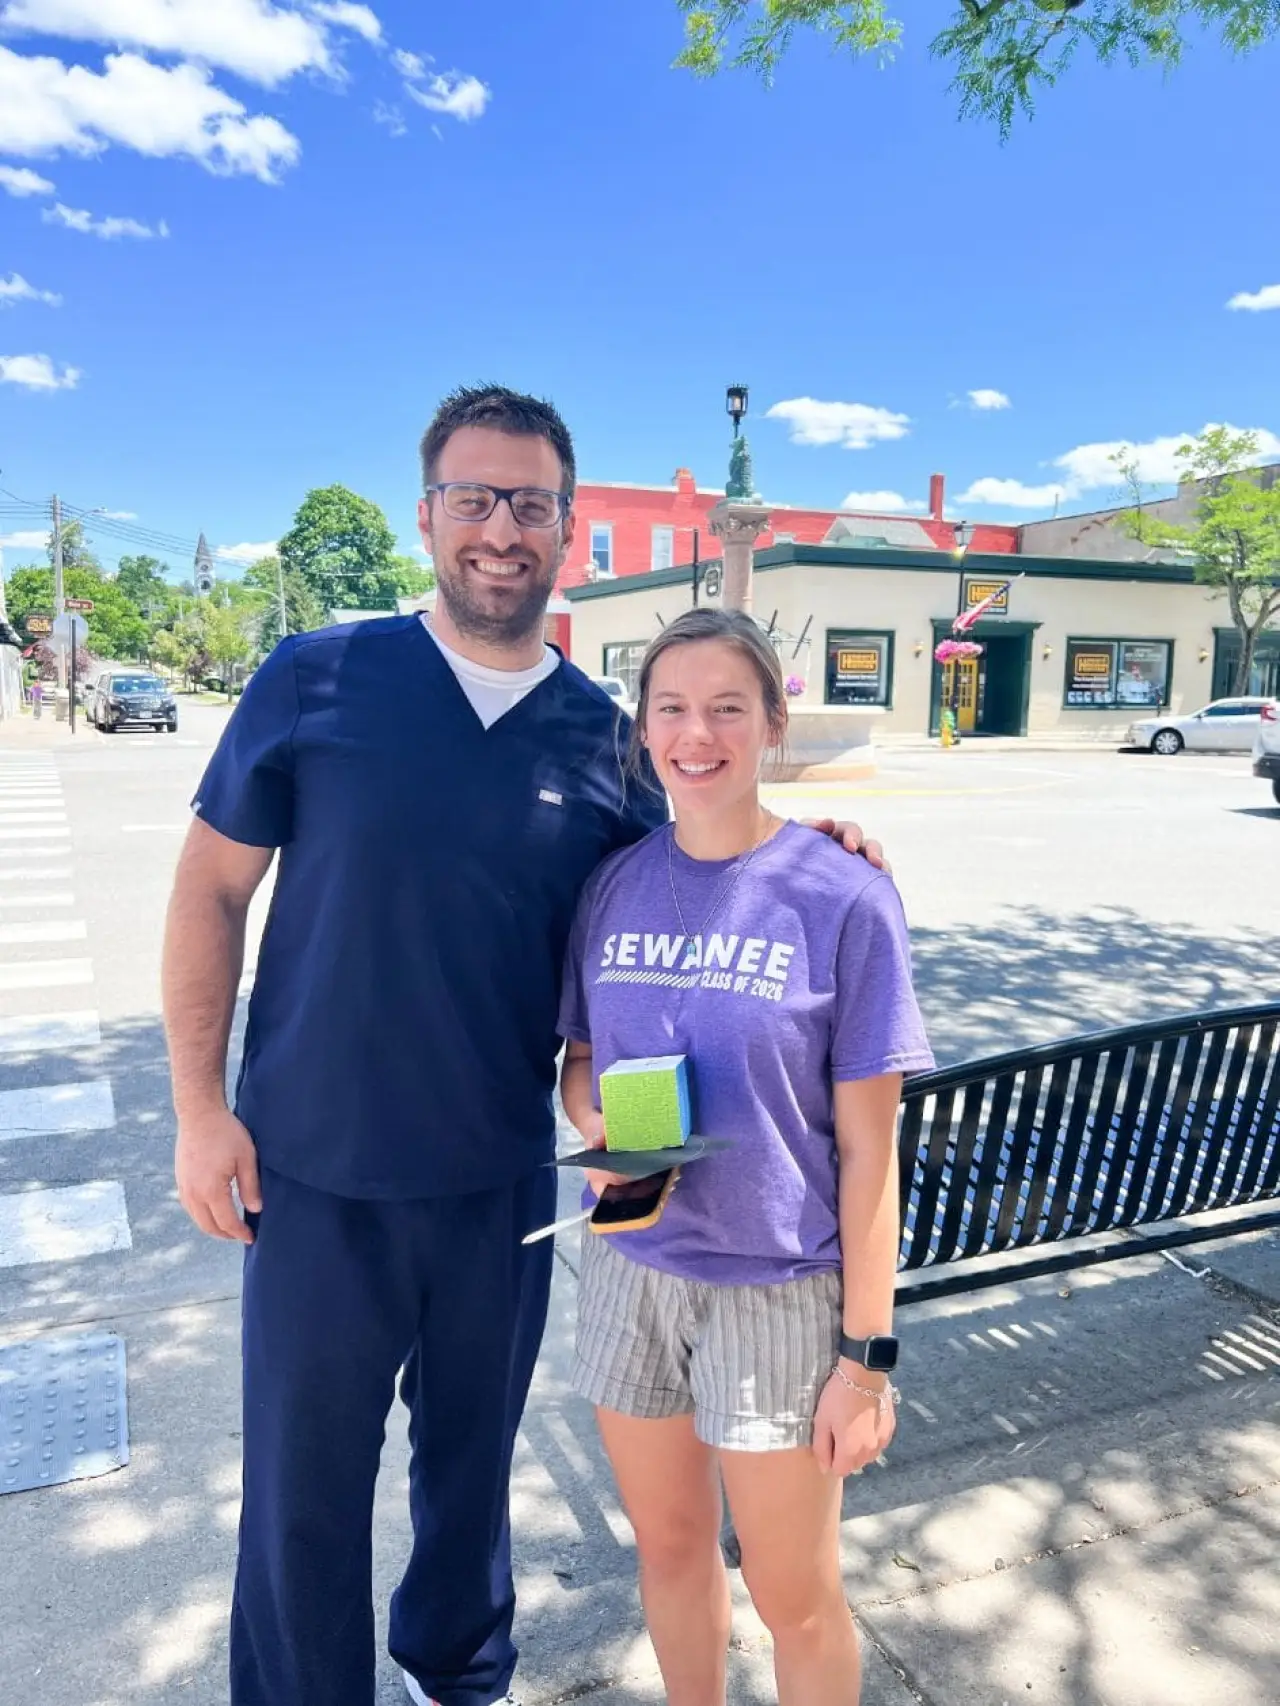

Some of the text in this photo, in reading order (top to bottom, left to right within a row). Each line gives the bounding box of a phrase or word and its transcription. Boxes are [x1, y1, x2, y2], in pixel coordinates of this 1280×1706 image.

[600, 933, 795, 981] SEWANEE
[701, 971, 733, 990] CLASS
[734, 976, 750, 993] OF
